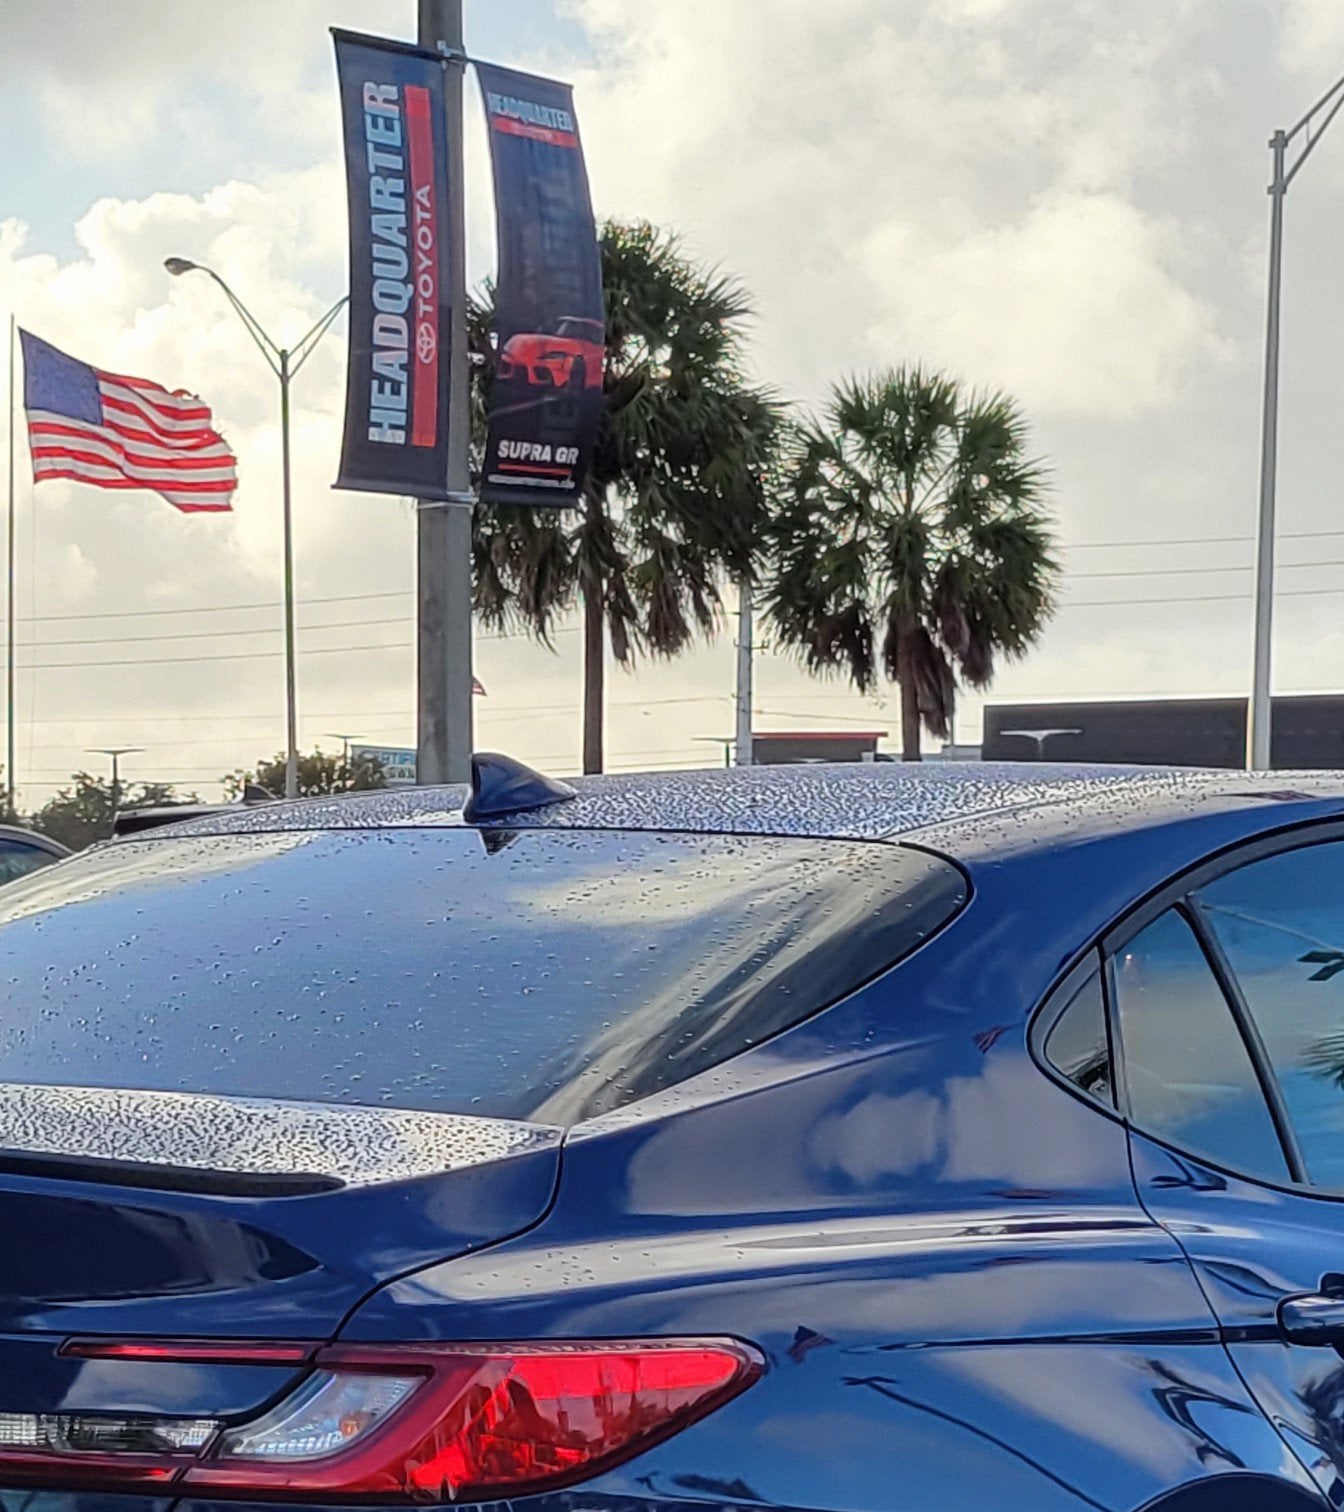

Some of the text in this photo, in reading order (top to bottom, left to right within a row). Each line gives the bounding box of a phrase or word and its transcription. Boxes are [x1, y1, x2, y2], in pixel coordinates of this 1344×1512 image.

[363, 81, 414, 445] HEADQUARTER
[416, 184, 433, 318] TOYOTA
[497, 439, 579, 465] SUPRA GR
